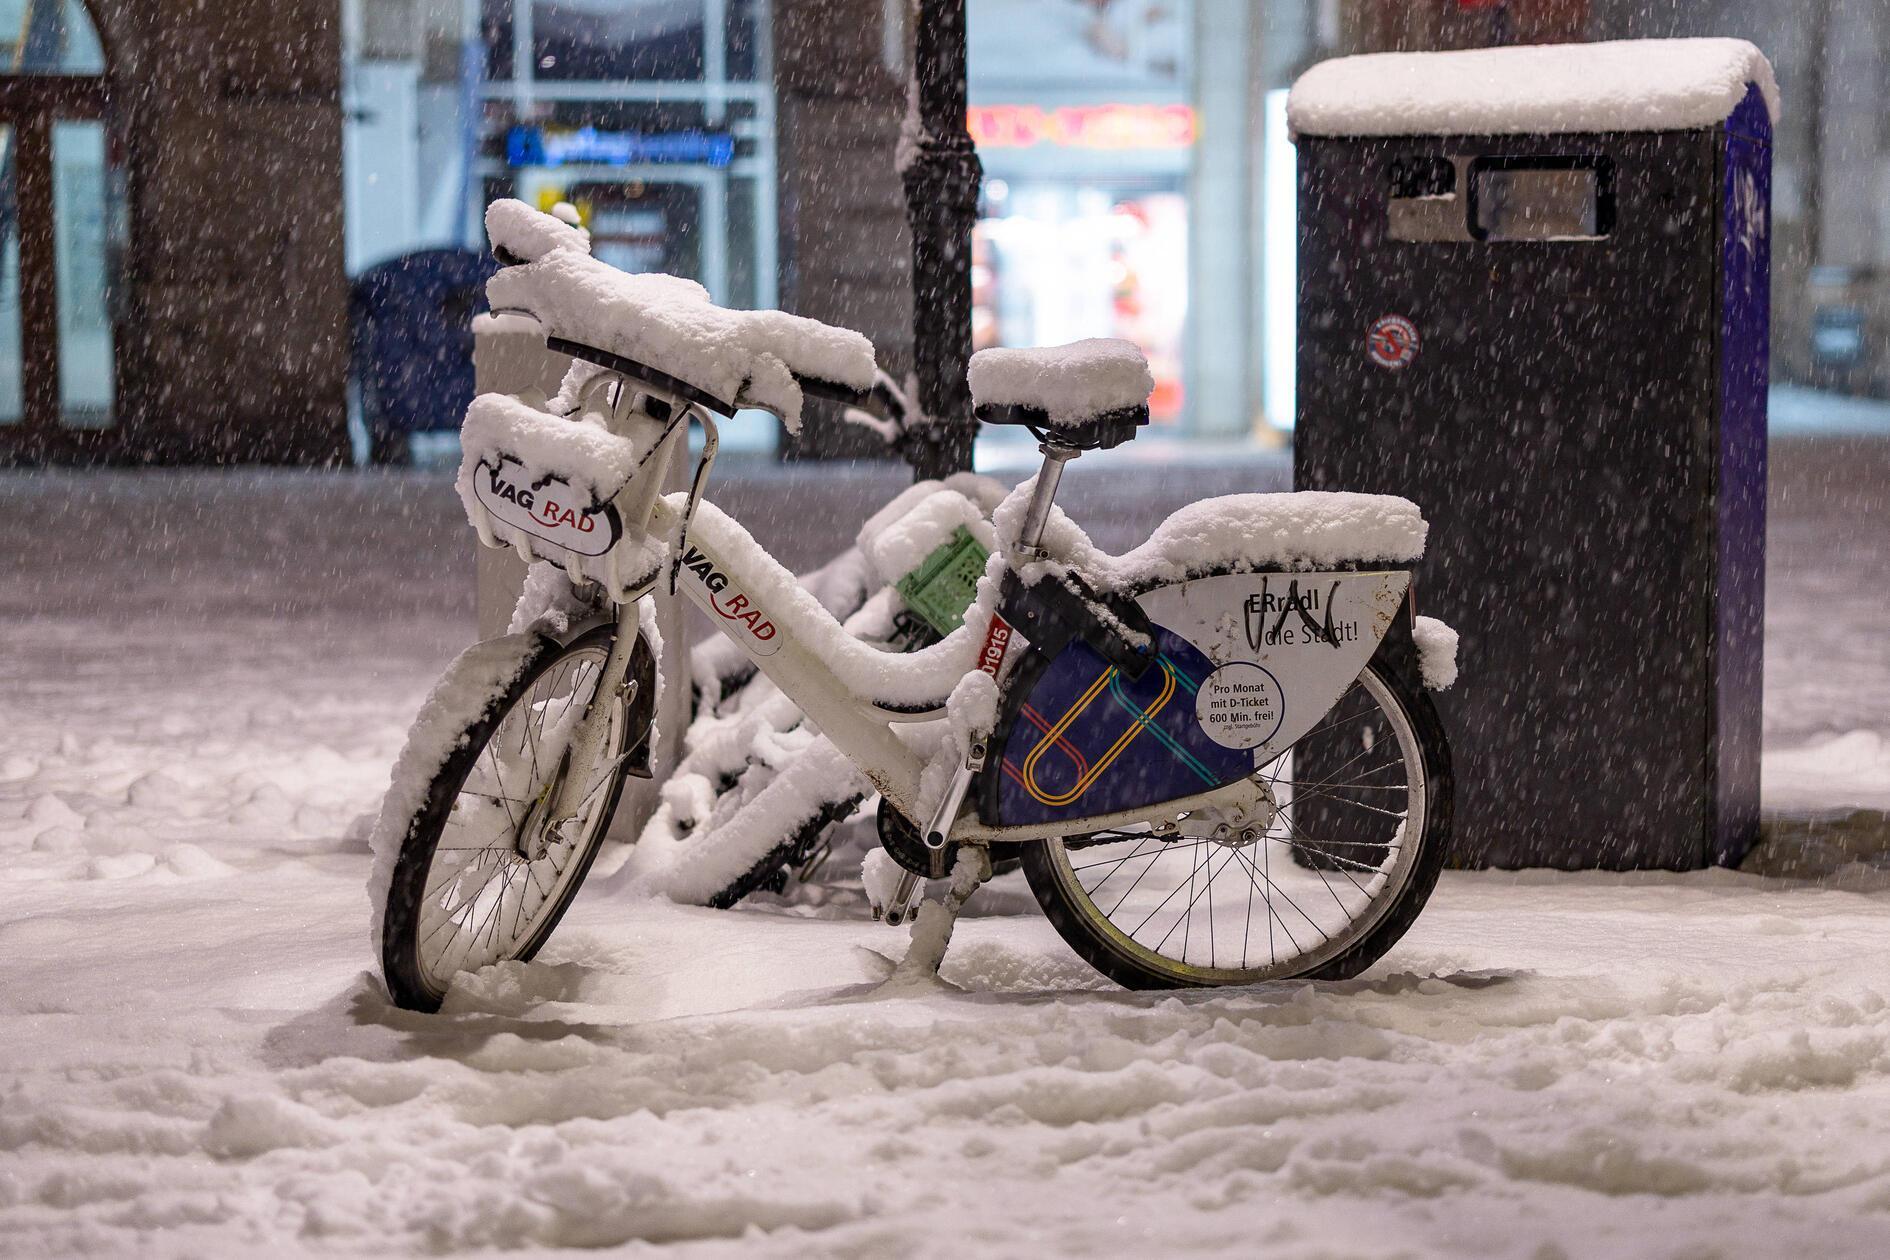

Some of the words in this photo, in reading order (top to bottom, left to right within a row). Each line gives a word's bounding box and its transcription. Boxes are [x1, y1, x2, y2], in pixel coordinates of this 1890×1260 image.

[491, 477, 535, 511] VAG
[543, 500, 595, 533] RAD
[681, 545, 729, 594] VAG
[724, 593, 776, 641] RAD
[1214, 685, 1230, 694] Pro
[1233, 683, 1265, 693] Monat
[1211, 698, 1227, 708] mit
[1230, 697, 1269, 708] D-Ticket
[1209, 713, 1228, 723] 600
[1230, 712, 1252, 722] Min.
[1255, 711, 1274, 721] frei!
